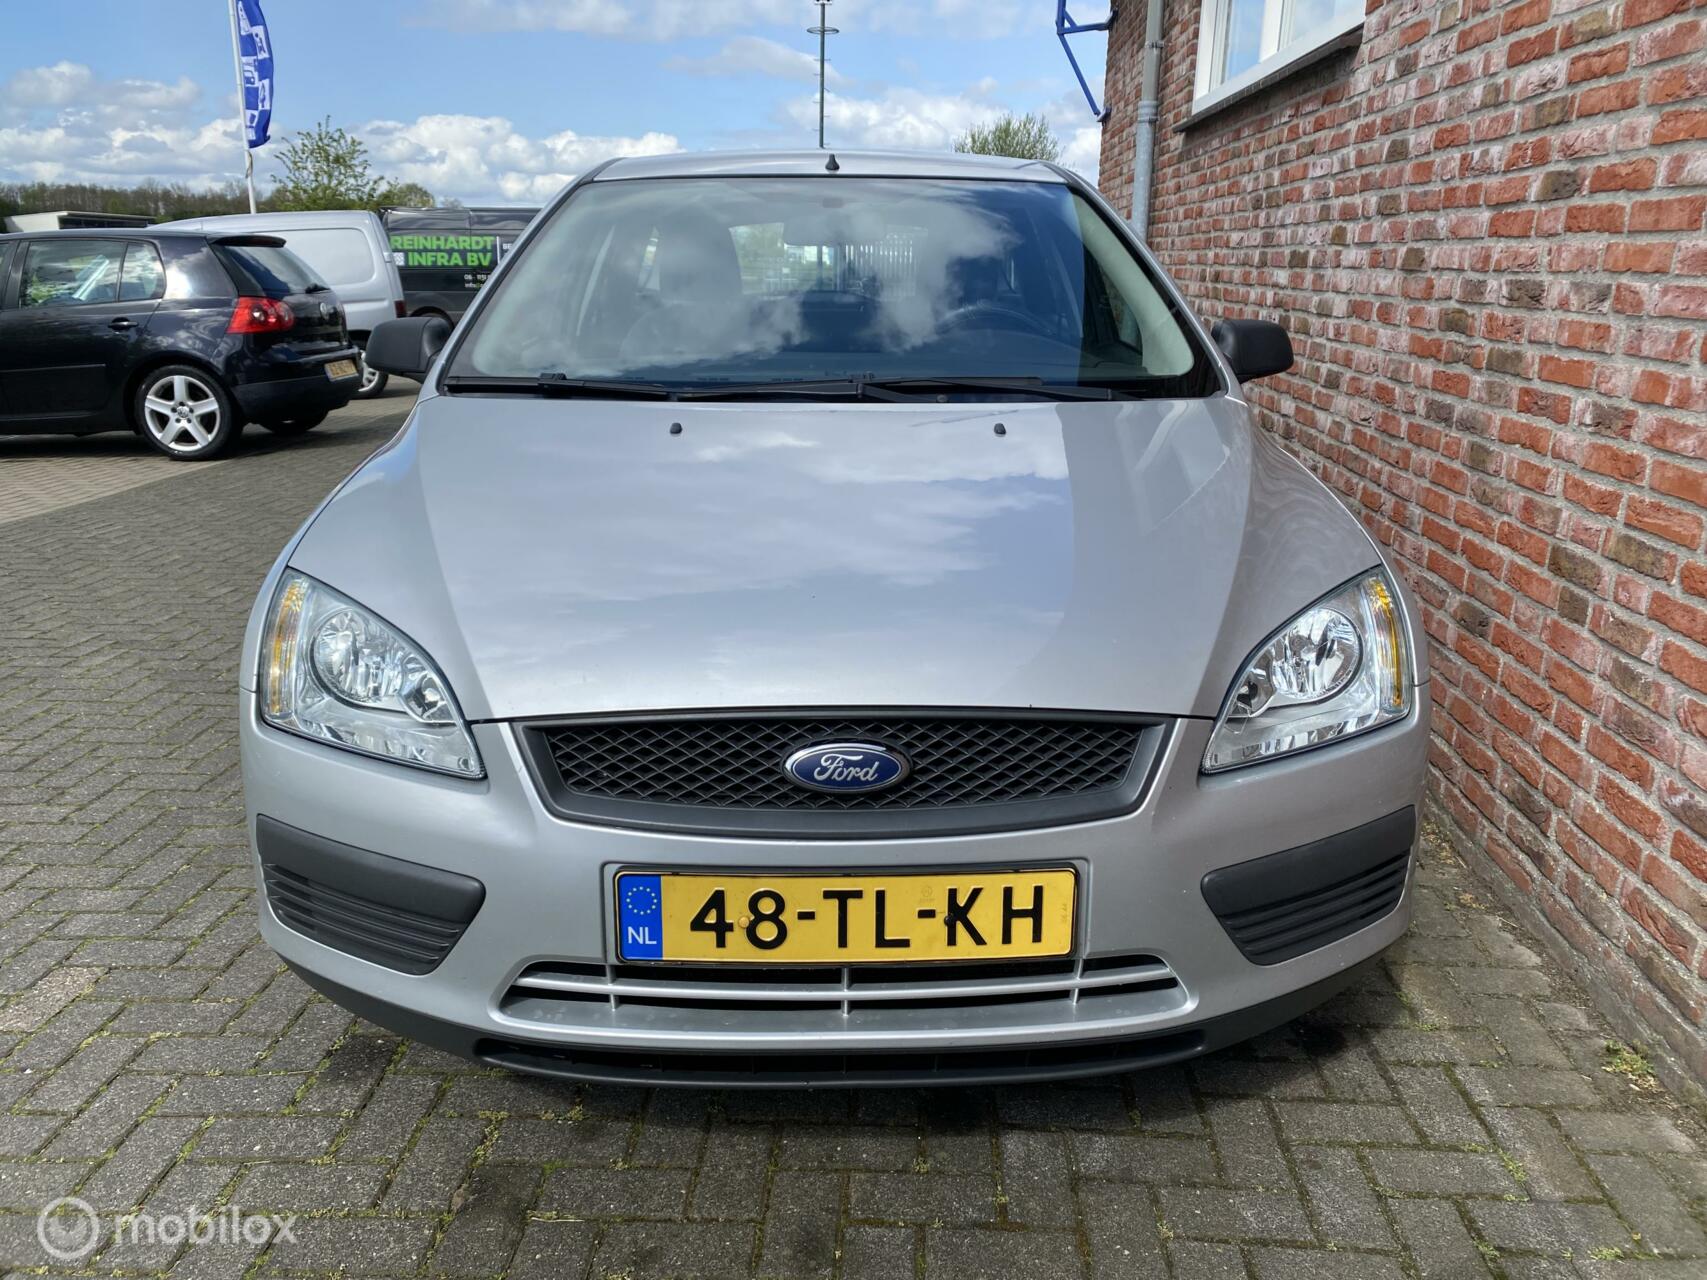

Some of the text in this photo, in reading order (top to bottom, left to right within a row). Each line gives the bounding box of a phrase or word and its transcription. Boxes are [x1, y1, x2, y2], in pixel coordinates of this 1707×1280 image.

[390, 235, 495, 250] REINHARDT
[408, 252, 492, 266] INFRA BV
[814, 753, 880, 781] Ford
[689, 885, 1044, 950] 48-TL-KH
[627, 926, 657, 945] NL
